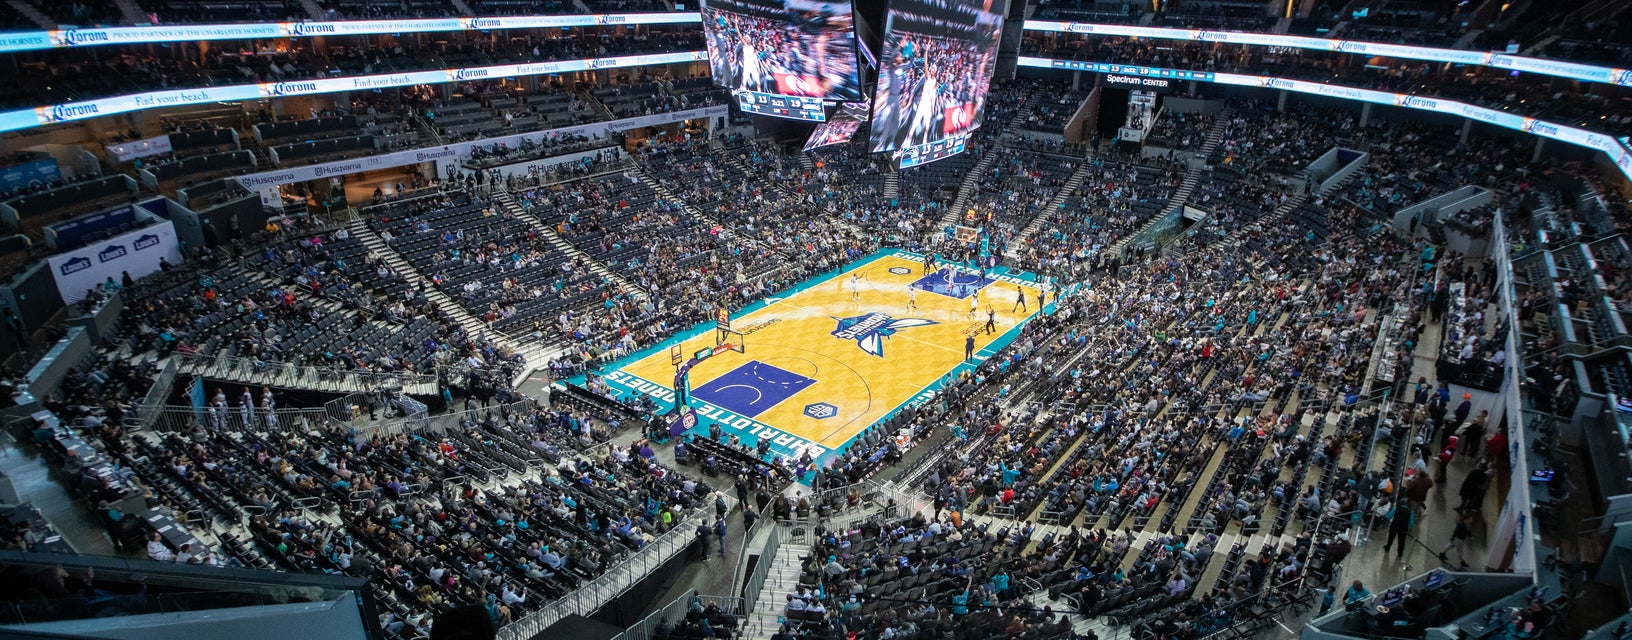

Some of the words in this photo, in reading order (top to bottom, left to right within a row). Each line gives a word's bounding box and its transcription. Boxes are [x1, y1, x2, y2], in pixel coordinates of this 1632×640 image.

[471, 17, 501, 29] Corona
[602, 14, 626, 24] Corona
[295, 21, 335, 36] Corona
[1067, 22, 1094, 32] Corona
[66, 29, 109, 46] Corona
[1198, 31, 1227, 41] Corona
[1339, 39, 1367, 51] Corona
[592, 58, 617, 68] Corona
[457, 68, 488, 80] Corona
[354, 78, 371, 88] Find
[373, 78, 389, 87] your
[1107, 74, 1140, 85] Spectrum
[1142, 79, 1168, 87] CENTER
[1267, 77, 1294, 88] Corona
[275, 81, 317, 96] Corona
[135, 95, 154, 107] Find
[156, 96, 178, 106] your
[758, 96, 768, 104] 13
[790, 99, 801, 108] 19
[1403, 95, 1437, 108] Corona
[53, 103, 99, 121] Corona
[423, 149, 456, 161] Husqvarna
[323, 162, 361, 176] Husqvarna
[537, 160, 580, 173] Husqarna
[251, 173, 294, 187] Husqvarna
[604, 370, 676, 404] ORNETS
[696, 404, 827, 459] CHARLOTTE
